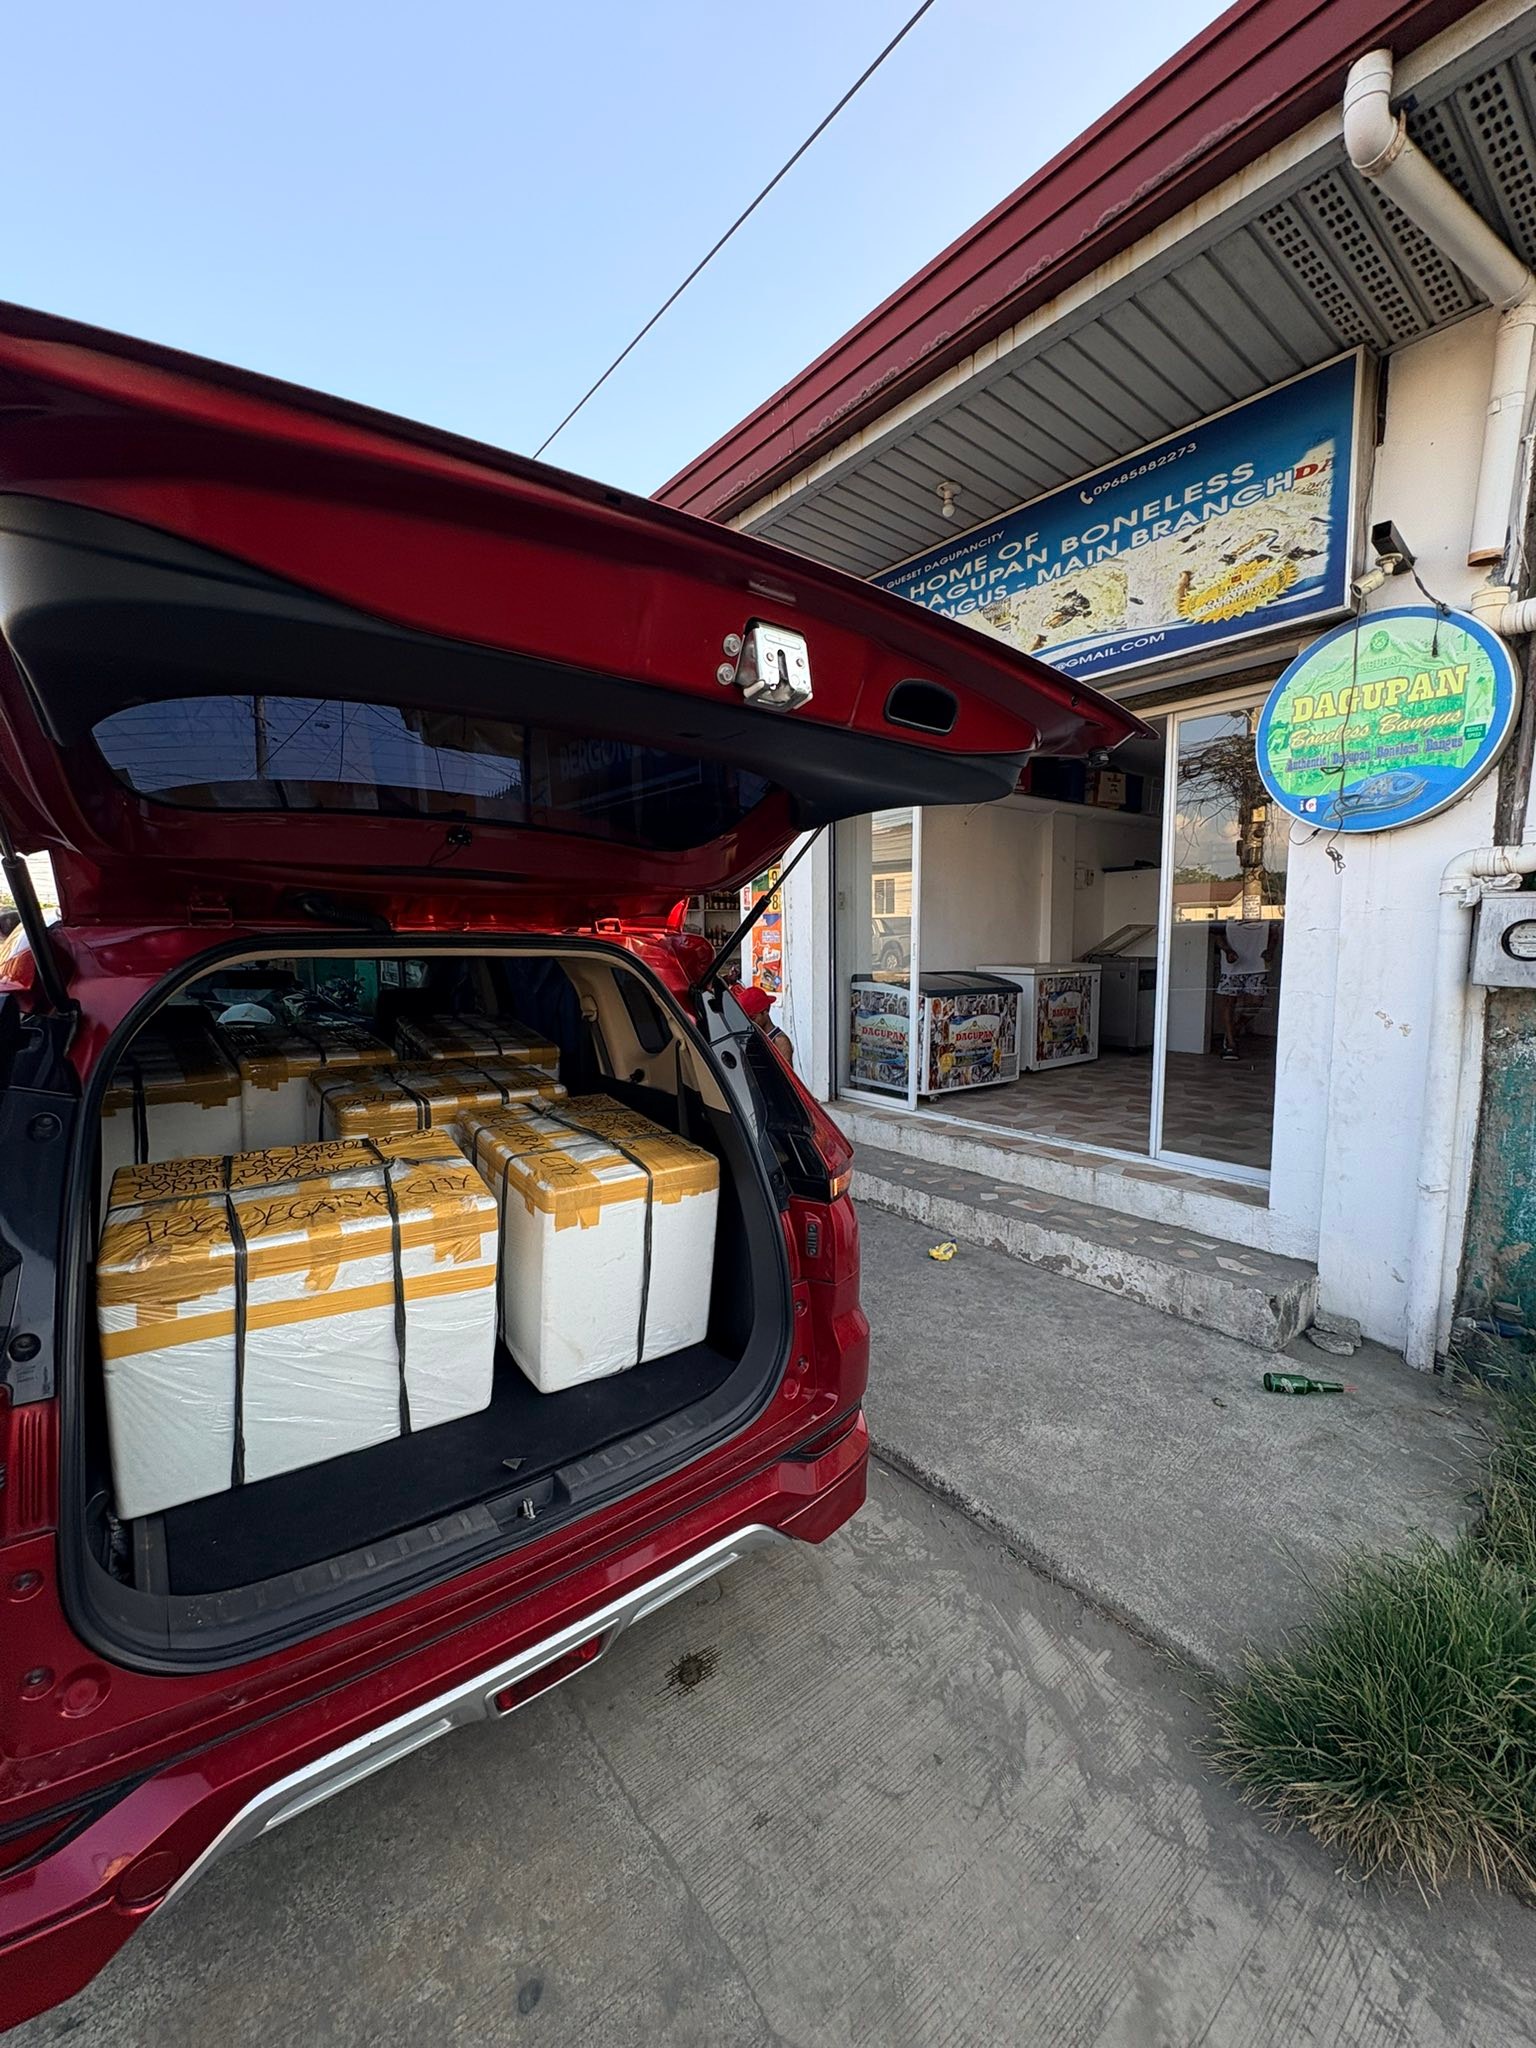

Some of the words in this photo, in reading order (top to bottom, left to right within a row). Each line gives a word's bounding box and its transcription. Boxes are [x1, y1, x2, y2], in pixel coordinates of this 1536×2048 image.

[1093, 442, 1197, 496] 09685882273
[916, 548, 1047, 609] AGUPAN
[1061, 462, 1254, 555] BONELESS
[1037, 539, 1118, 585] MAIN
[1132, 467, 1295, 548] BRANCH
[886, 568, 922, 589] GUESET
[924, 530, 1005, 573] DAGUPANCITY
[910, 555, 988, 600] HOME
[998, 532, 1039, 560] OF
[1052, 632, 1166, 671] @GMAIL.COM
[1292, 663, 1471, 724] DAGUPAN
[1290, 724, 1370, 750] Boneless
[1380, 709, 1464, 734] Bangus
[1424, 736, 1464, 753] Bangus
[862, 1026, 906, 1042] DAGUPAN
[956, 1031, 993, 1041] DAGUPAN
[406, 1174, 471, 1193] CITY
[540, 1156, 582, 1175] CITY
